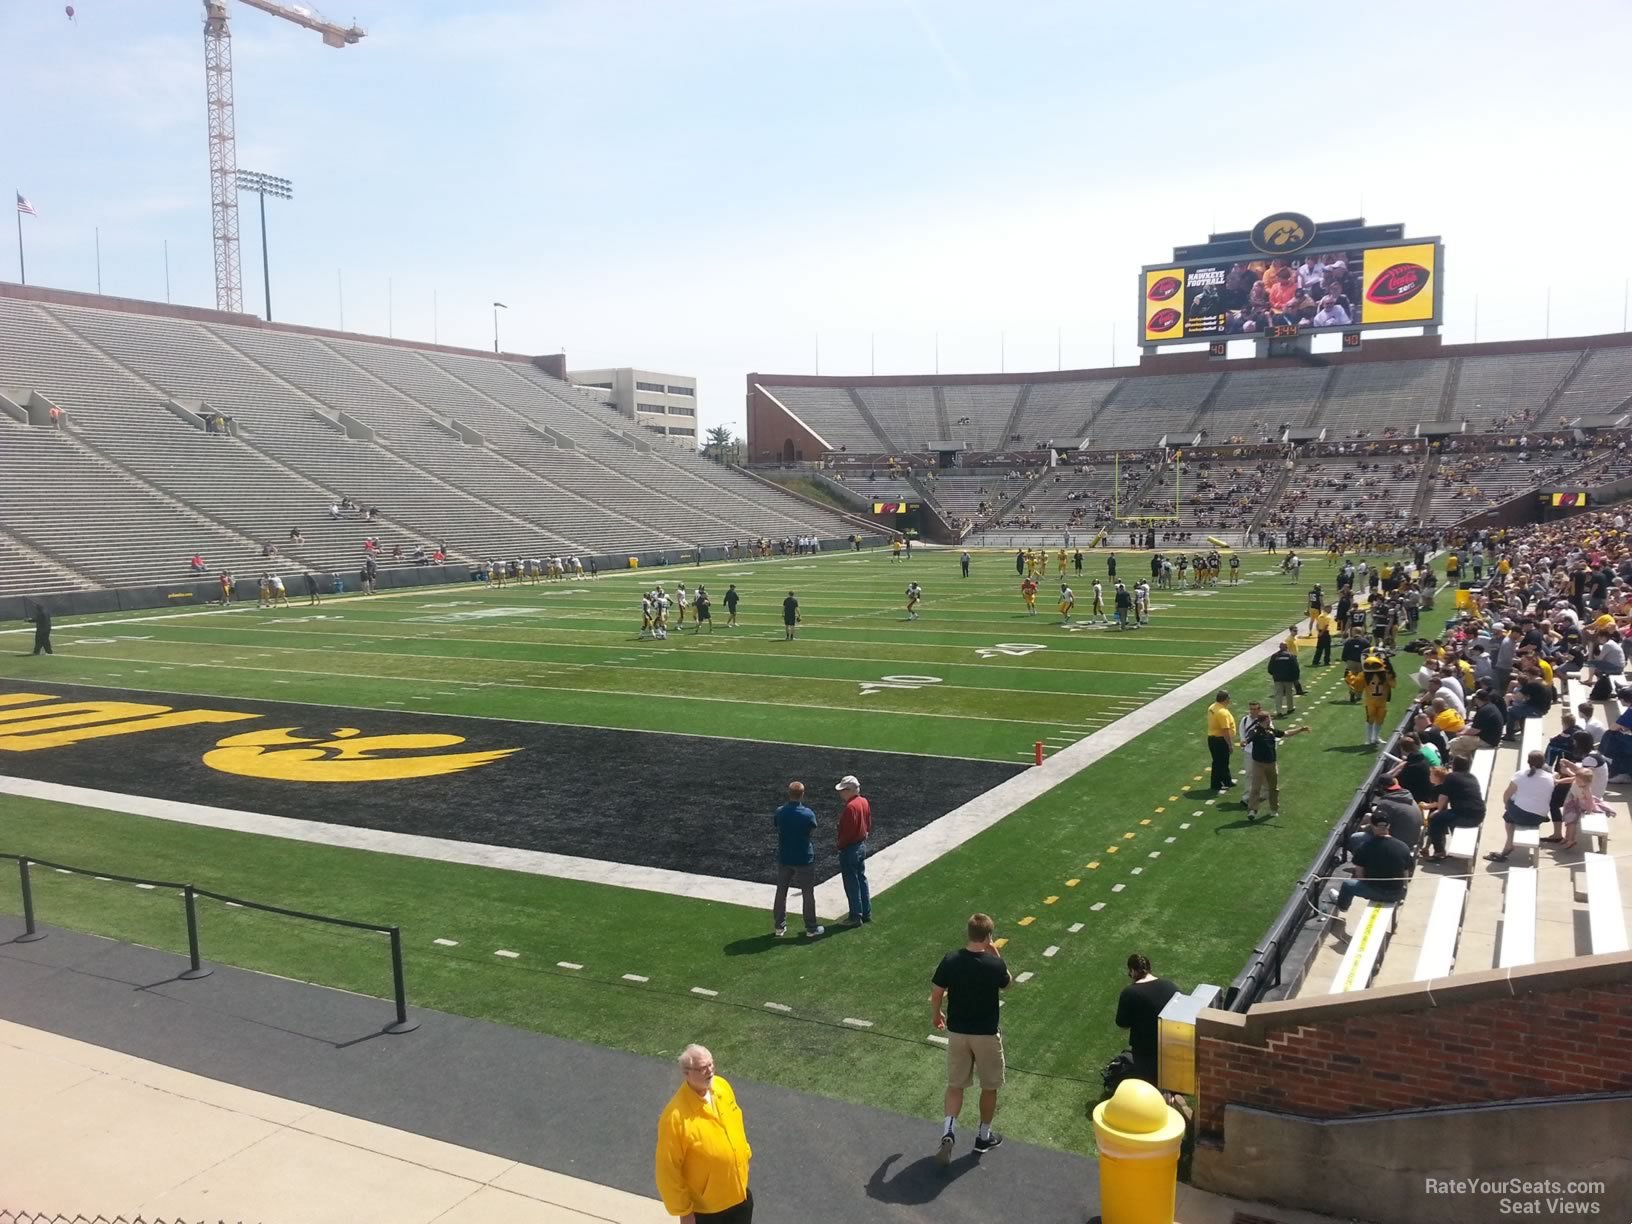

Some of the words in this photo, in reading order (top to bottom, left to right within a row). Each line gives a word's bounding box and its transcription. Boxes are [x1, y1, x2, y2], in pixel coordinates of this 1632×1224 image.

[1188, 271, 1225, 280] HAWKEYE
[1187, 278, 1225, 287] FOOTBALL
[1211, 344, 1224, 354] 40
[1353, 613, 1365, 622] 97
